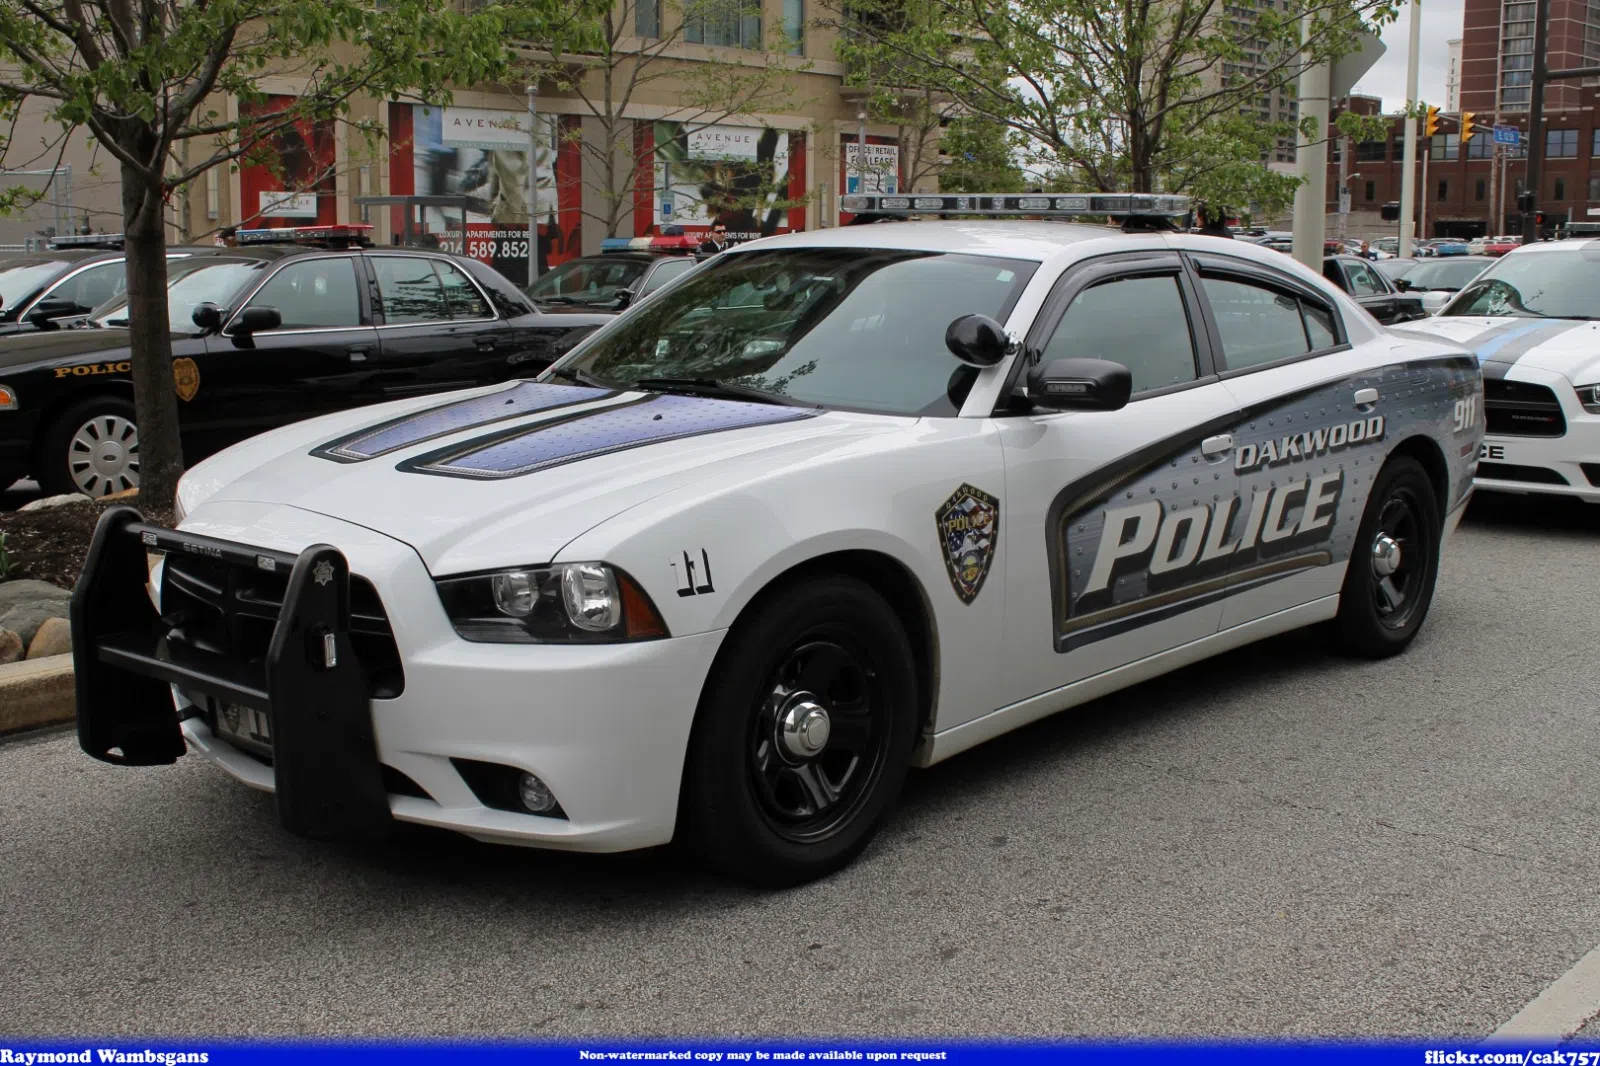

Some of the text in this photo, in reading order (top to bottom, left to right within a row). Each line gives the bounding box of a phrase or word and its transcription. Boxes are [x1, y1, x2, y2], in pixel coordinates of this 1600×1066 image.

[696, 132, 750, 144] AVENUE
[848, 145, 872, 154] OFCE
[875, 147, 897, 156] RETAIL
[869, 156, 895, 167] LEASE
[439, 230, 530, 239] LUXURY APARTMENTS FOR RE
[704, 231, 737, 240] APENTS
[439, 241, 530, 258] 216.589.852
[54, 361, 131, 378] POLIC
[1452, 397, 1476, 433] 911
[1235, 416, 1385, 473] OAKWOOD
[946, 486, 989, 509] OAKWOOD
[948, 510, 993, 533] POLICE
[1077, 471, 1345, 602] POLICE
[183, 542, 223, 559] SETINA
